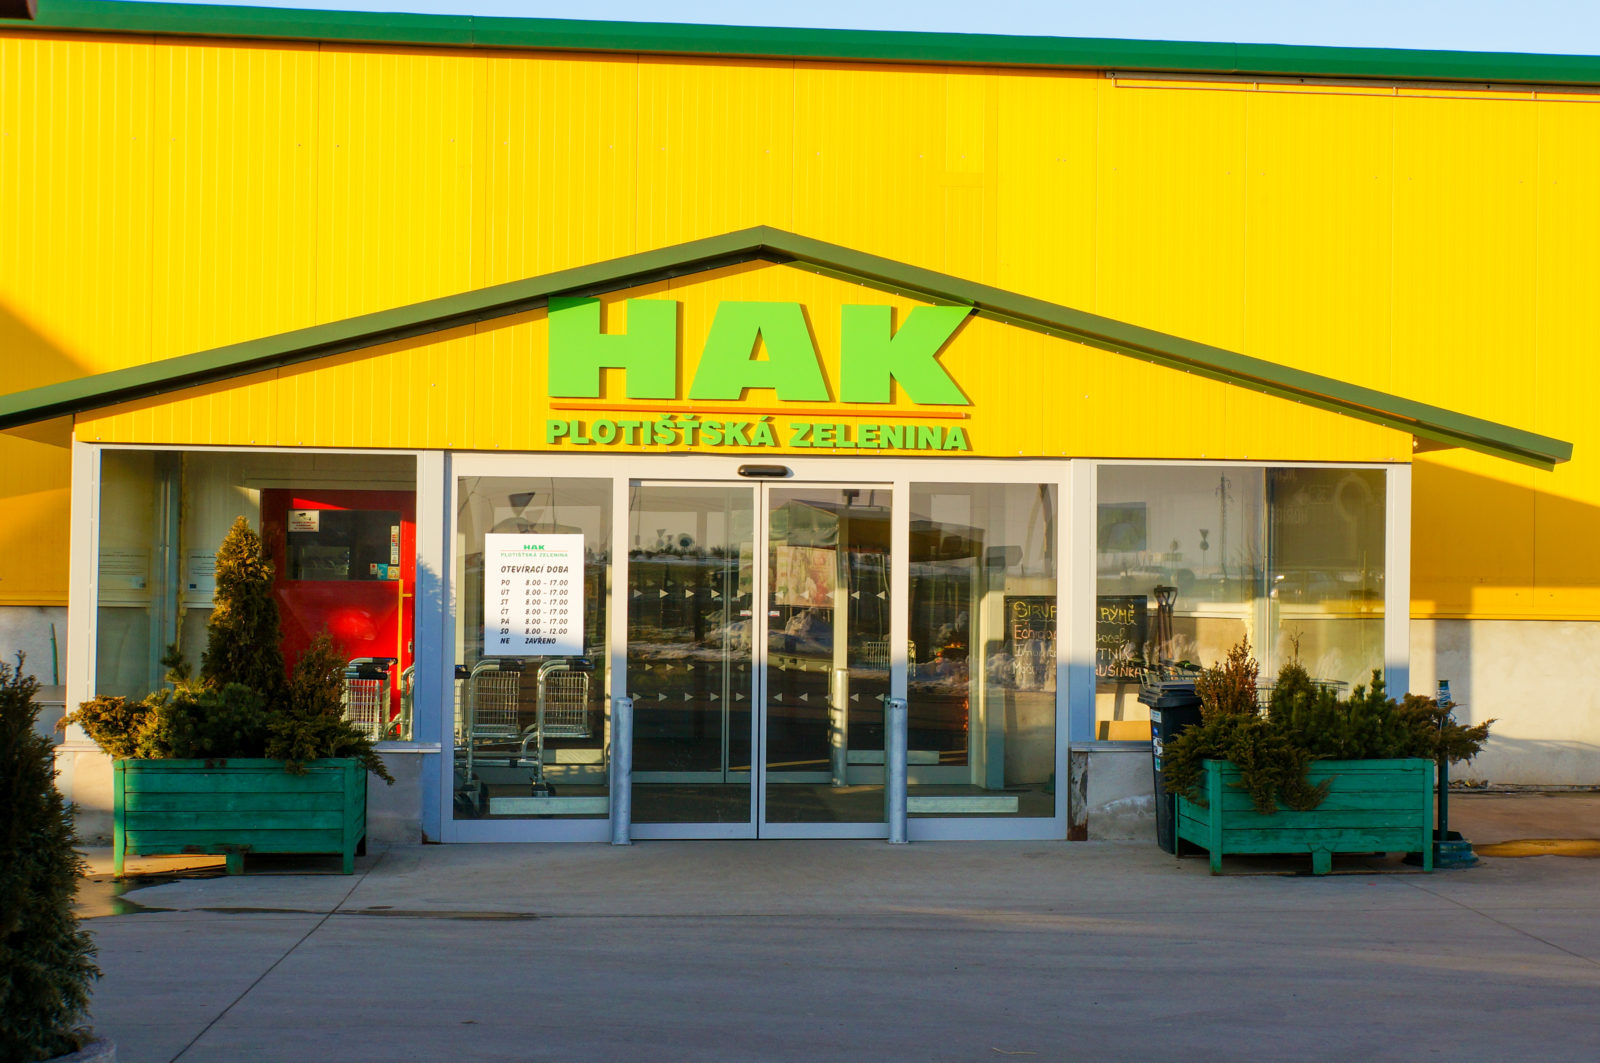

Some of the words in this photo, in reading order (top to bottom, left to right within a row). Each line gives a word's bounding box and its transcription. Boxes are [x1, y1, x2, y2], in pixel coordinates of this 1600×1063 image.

[547, 297, 976, 405] HAK
[546, 414, 776, 447] PLOTIŠŤSKÁ
[788, 422, 969, 450] ZELENINA
[500, 564, 544, 573] OTEVÍRACÍ
[546, 565, 568, 573] DOBA
[1100, 604, 1135, 623] RÝMĚ
[525, 636, 556, 644] ZAVŘENO
